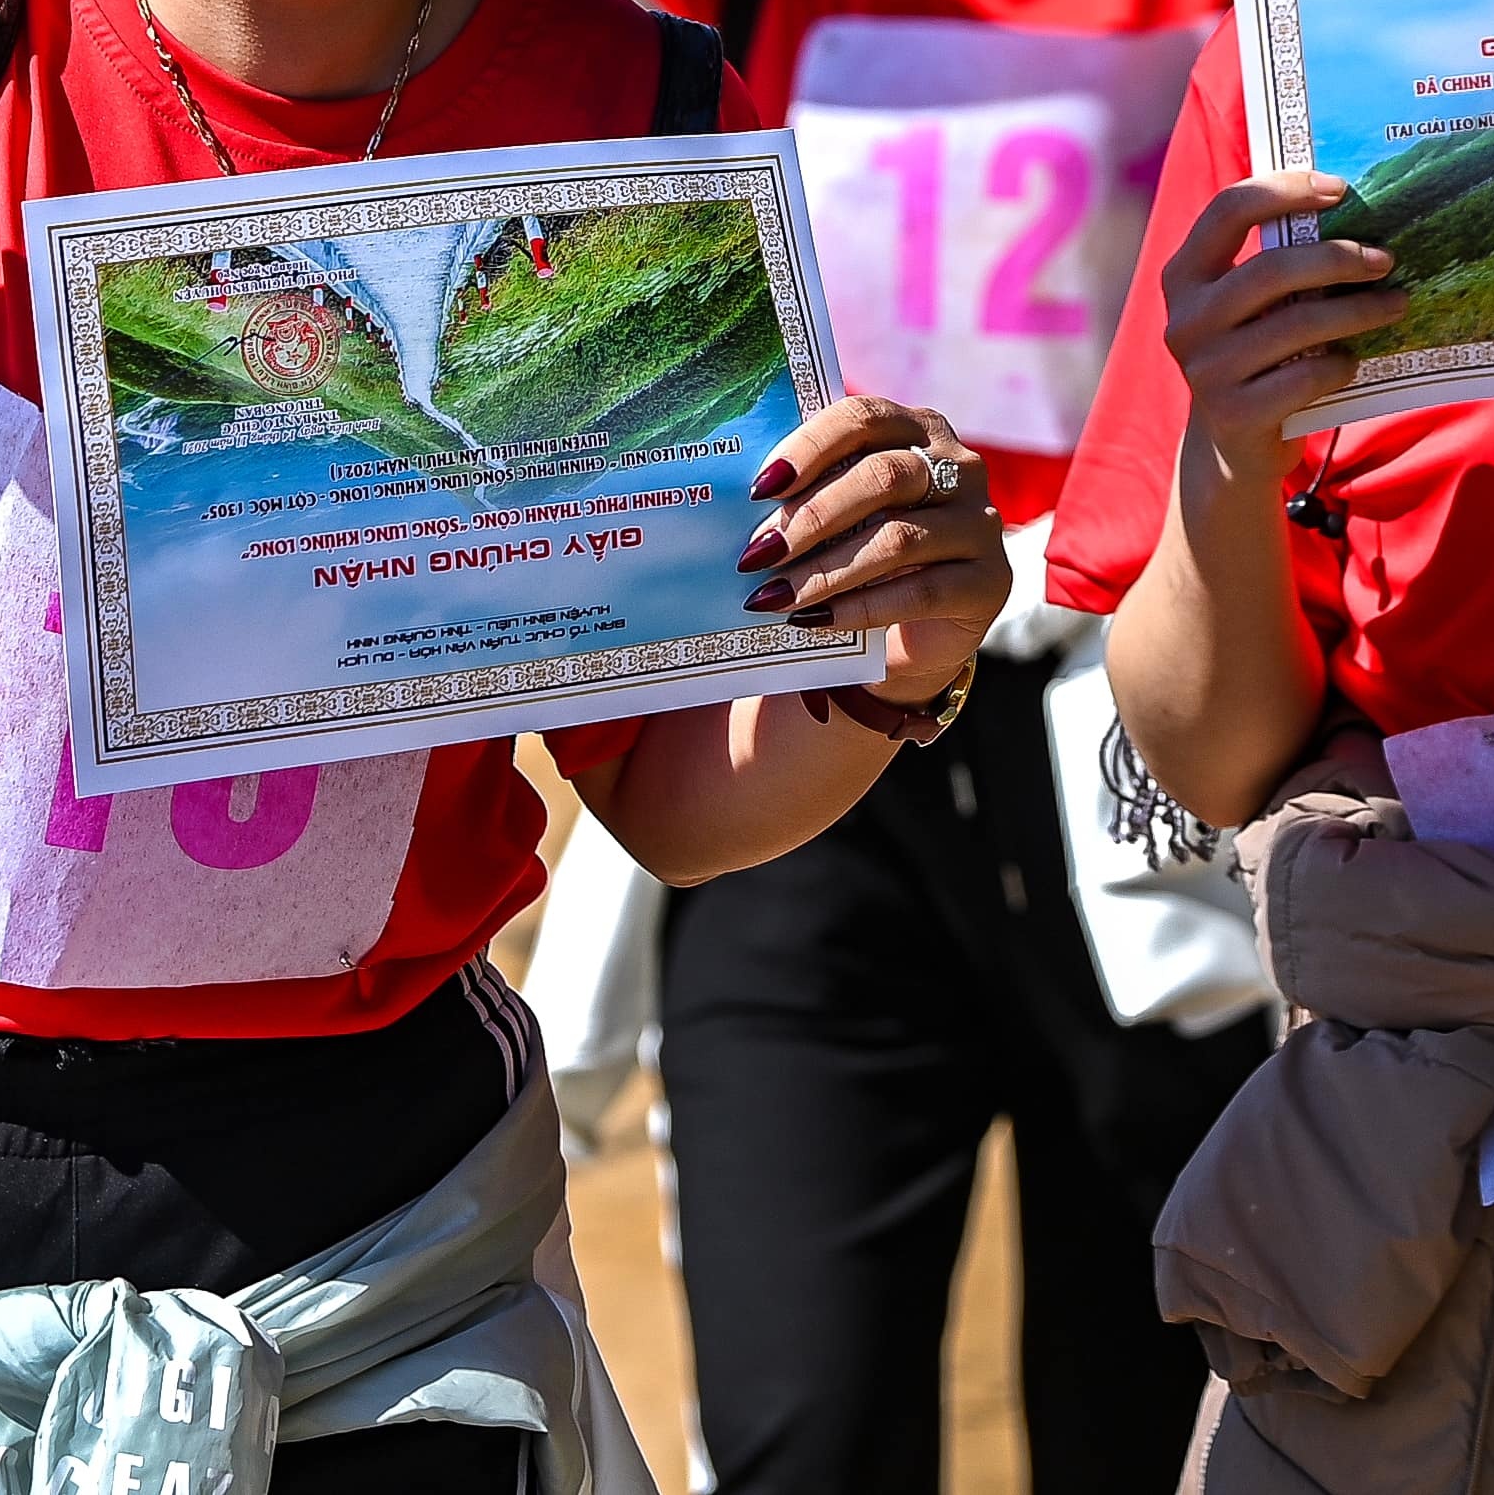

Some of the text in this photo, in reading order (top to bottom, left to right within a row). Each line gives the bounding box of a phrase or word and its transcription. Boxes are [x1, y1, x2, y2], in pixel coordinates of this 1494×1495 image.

[1416, 77, 1437, 95] ĐÃ
[1441, 73, 1491, 92] CHINH
[1449, 117, 1473, 131] LEO
[869, 118, 1169, 337] 12
[559, 455, 604, 474] CHINH
[649, 446, 676, 462] LEO
[285, 488, 316, 510] CỘT
[329, 485, 369, 504] LONG
[372, 478, 426, 502] KHỦNG
[632, 488, 682, 508] CHINH
[685, 484, 712, 505] ĐÃ
[248, 496, 282, 518] MỐC
[524, 501, 580, 525] THÀNH
[583, 491, 627, 515] PHỤC
[472, 509, 521, 533] CÔNG
[299, 529, 359, 556] KHỦNG
[363, 523, 407, 544] LƯNG
[312, 526, 645, 592] GIẤY CHỨNG NHẬN
